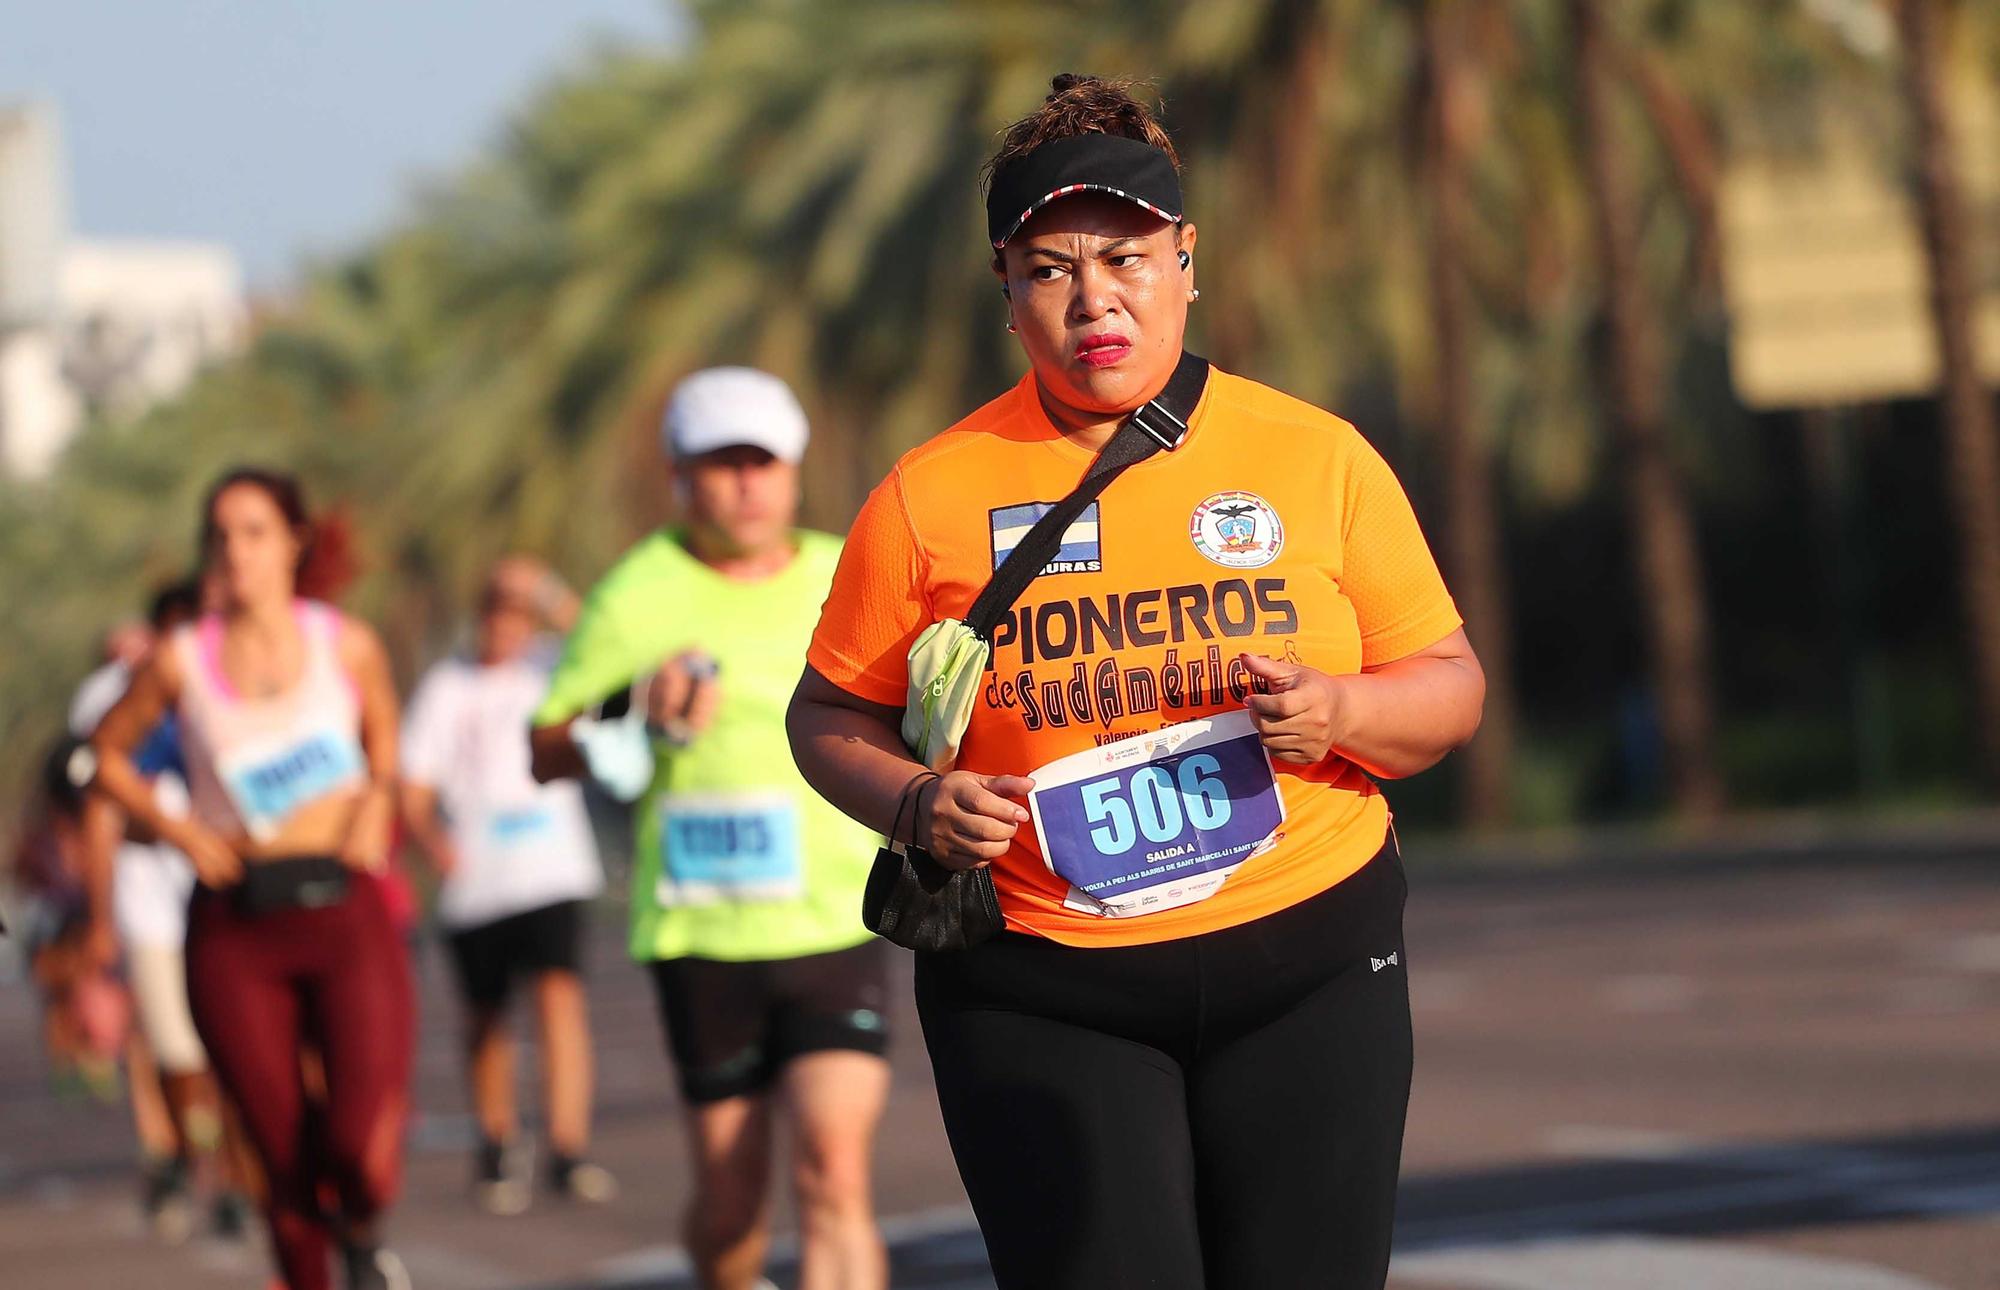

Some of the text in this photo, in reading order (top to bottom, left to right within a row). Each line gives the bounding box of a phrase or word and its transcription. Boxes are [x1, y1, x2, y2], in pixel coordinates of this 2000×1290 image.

[1038, 560, 1101, 576] URAS
[985, 578, 1298, 671] PIONEROS
[985, 670, 1017, 711] de
[1080, 753, 1232, 856] 506
[1084, 881, 1105, 892] VOLTA
[1106, 879, 1113, 887] A
[1113, 876, 1126, 885] PEU
[1127, 872, 1140, 881] ALS
[1140, 866, 1165, 877] BARRIS
[1166, 863, 1175, 872] DE
[1176, 857, 1195, 867] SANT
[1233, 843, 1251, 854] SANT
[1146, 843, 1195, 862] SALIDA A
[1370, 957, 1387, 972] USA
